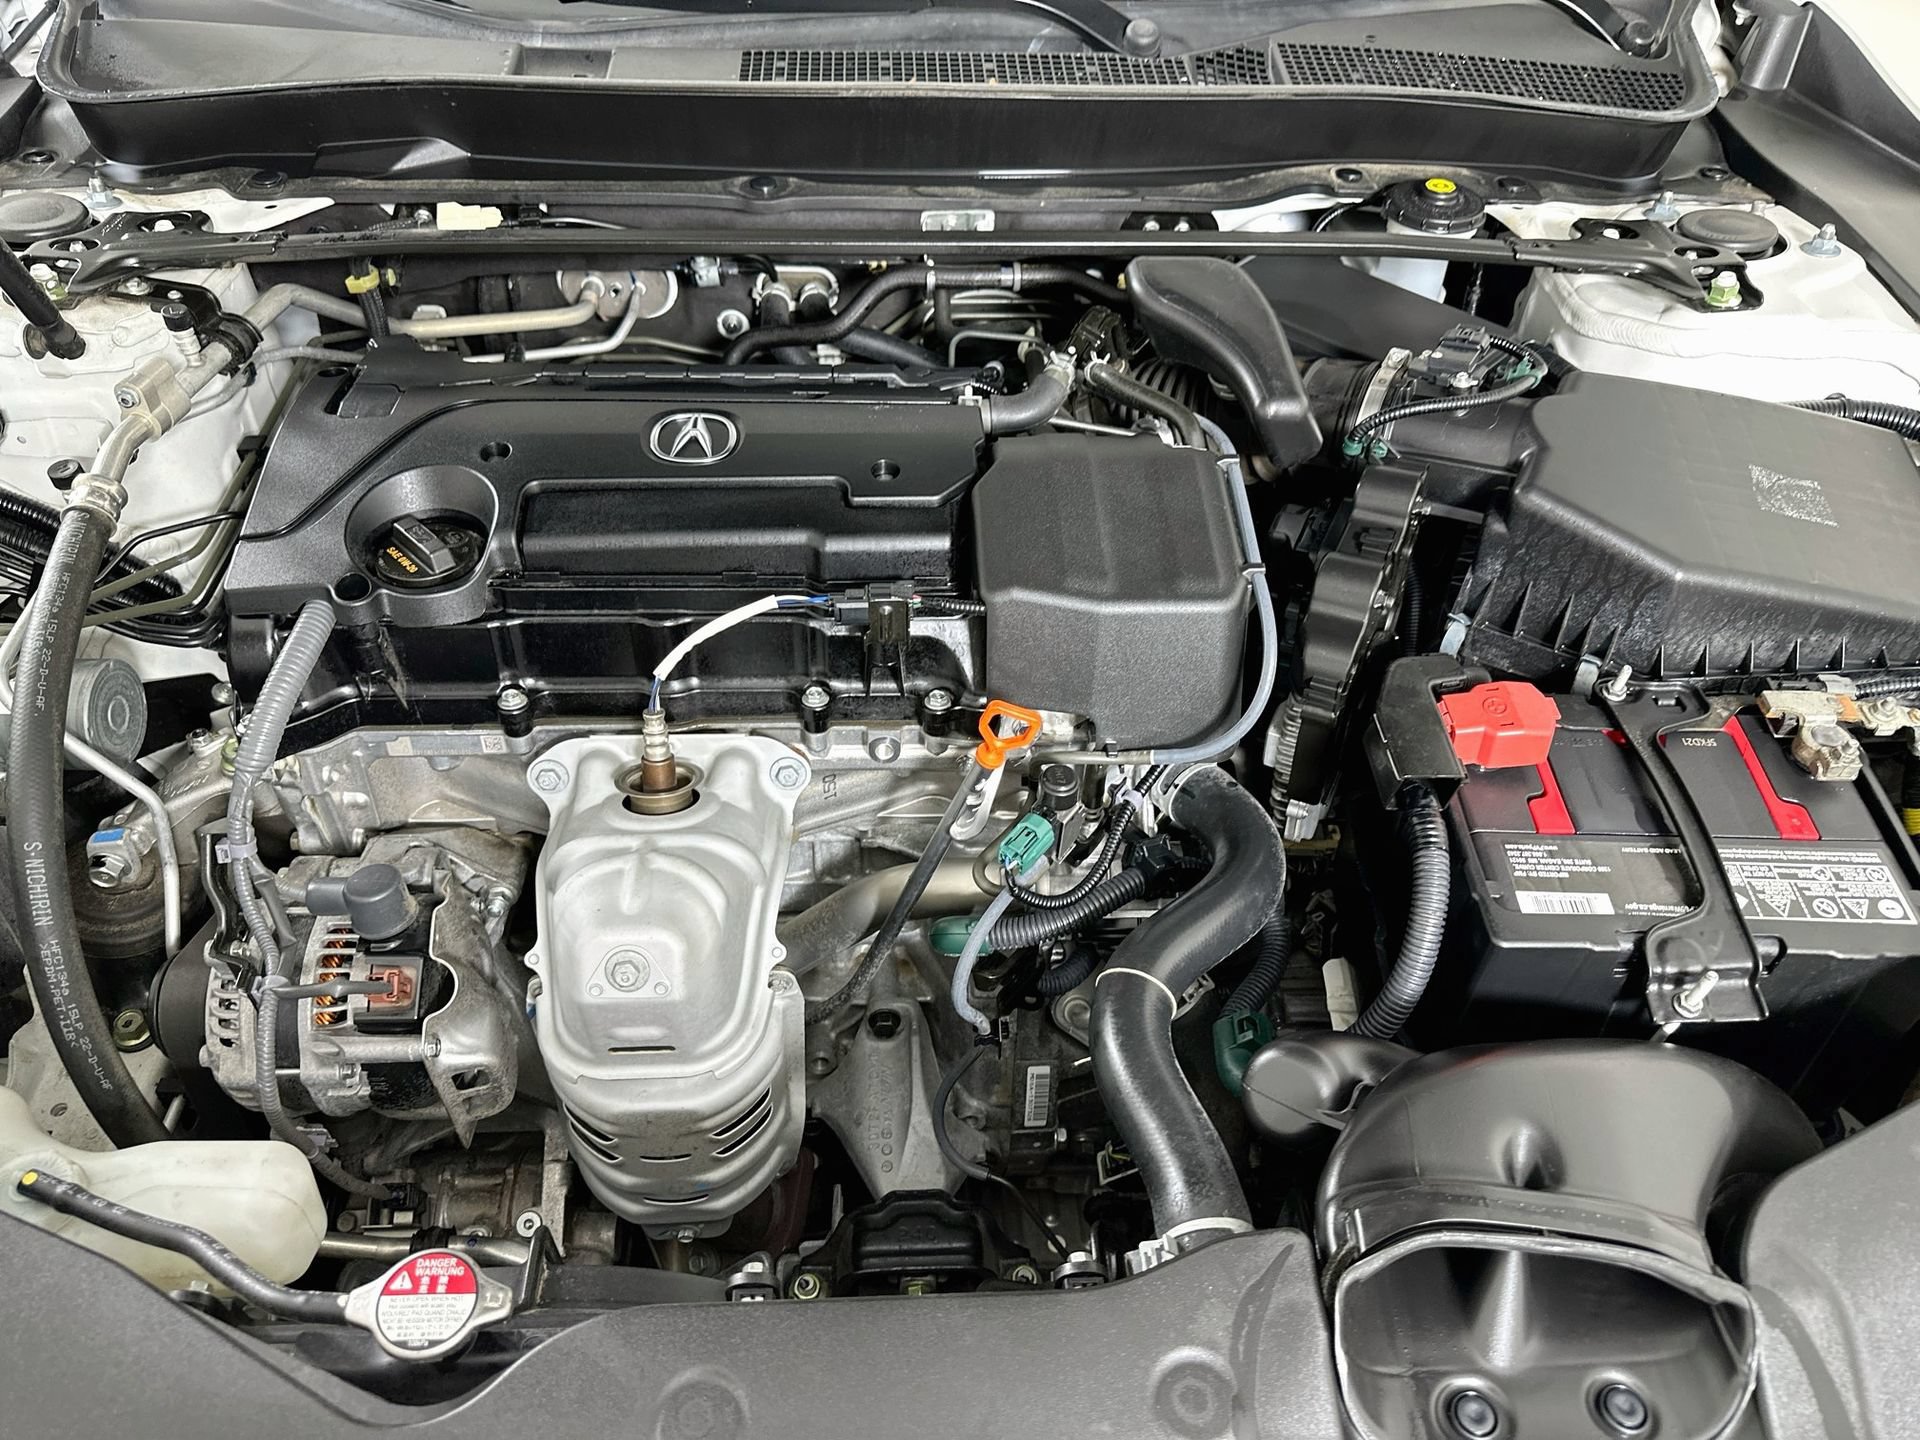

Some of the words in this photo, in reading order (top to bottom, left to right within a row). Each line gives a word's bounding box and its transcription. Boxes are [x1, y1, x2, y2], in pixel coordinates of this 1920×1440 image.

[386, 546, 403, 560] SAE
[416, 1257, 457, 1268] DANGER
[414, 1266, 465, 1277] WARNUNG
